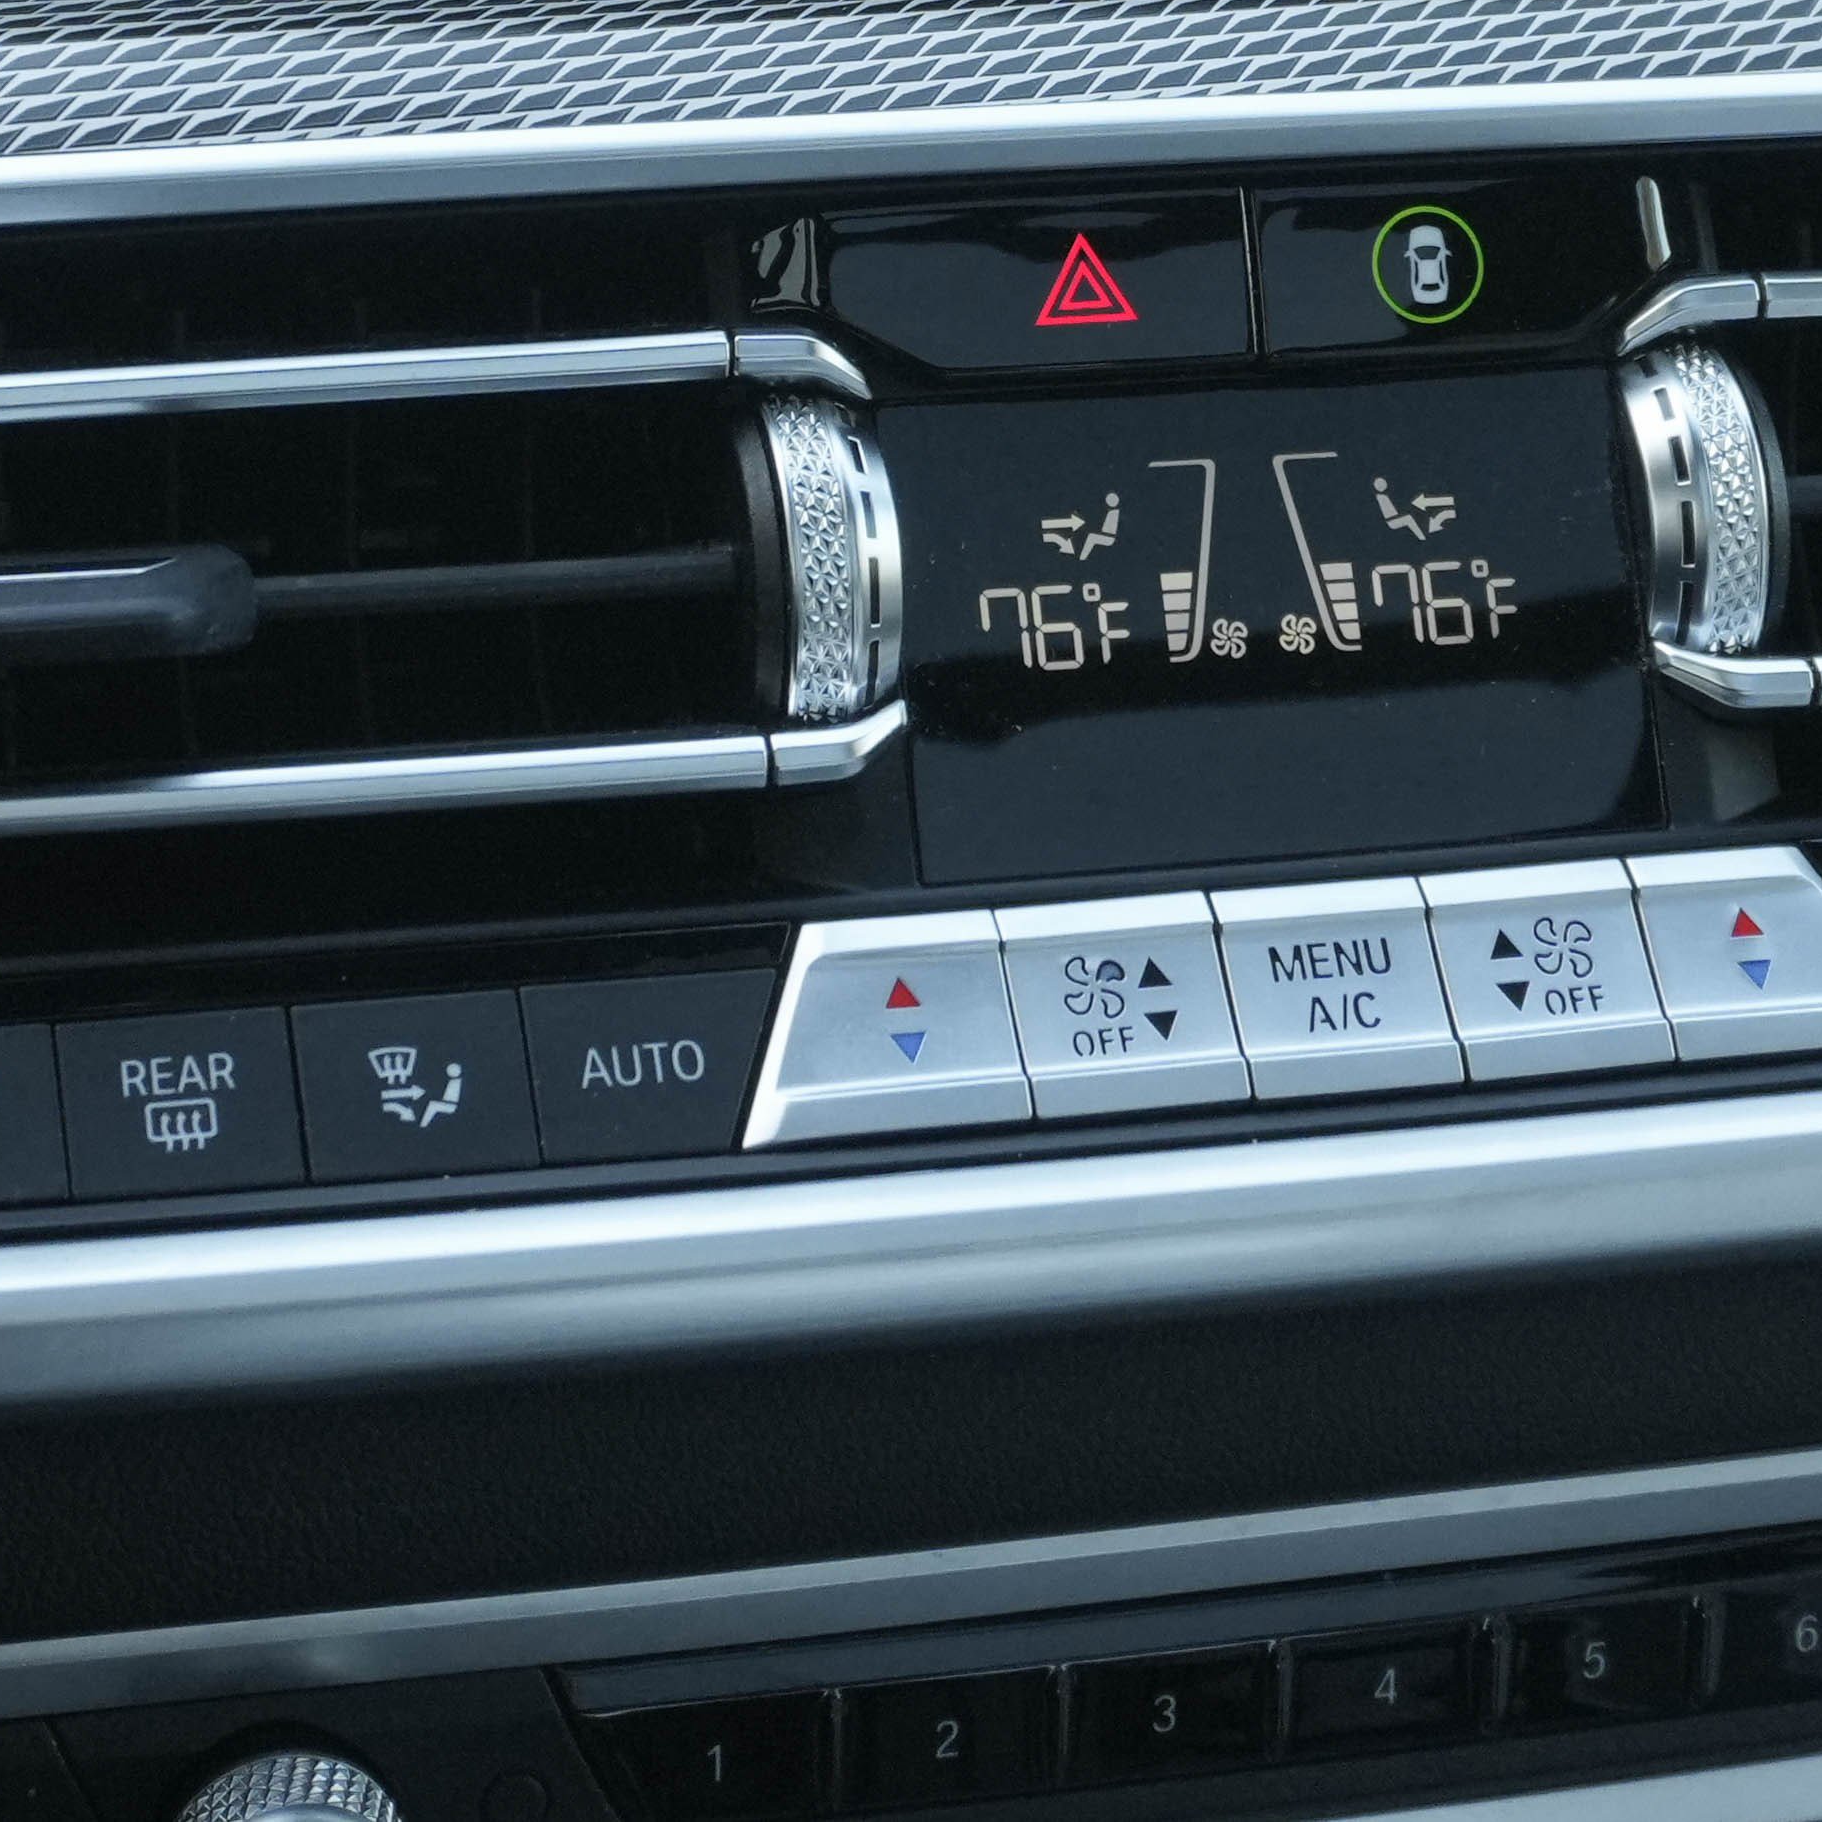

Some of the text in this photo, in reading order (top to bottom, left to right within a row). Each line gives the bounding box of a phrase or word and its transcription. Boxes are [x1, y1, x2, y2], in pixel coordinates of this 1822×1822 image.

[1268, 936, 1393, 984] MENU
[1308, 990, 1382, 1034] A/C
[1543, 983, 1605, 1016] OFF
[1071, 1025, 1135, 1058] OFF
[120, 1052, 236, 1097] REAR
[581, 1039, 706, 1089] AUTO
[1794, 1614, 1819, 1653] 6
[1582, 1641, 1608, 1679] 5
[1373, 1668, 1398, 1705] 4
[1152, 1694, 1177, 1733] 3
[935, 1720, 960, 1759] 2
[706, 1744, 723, 1782] 1
